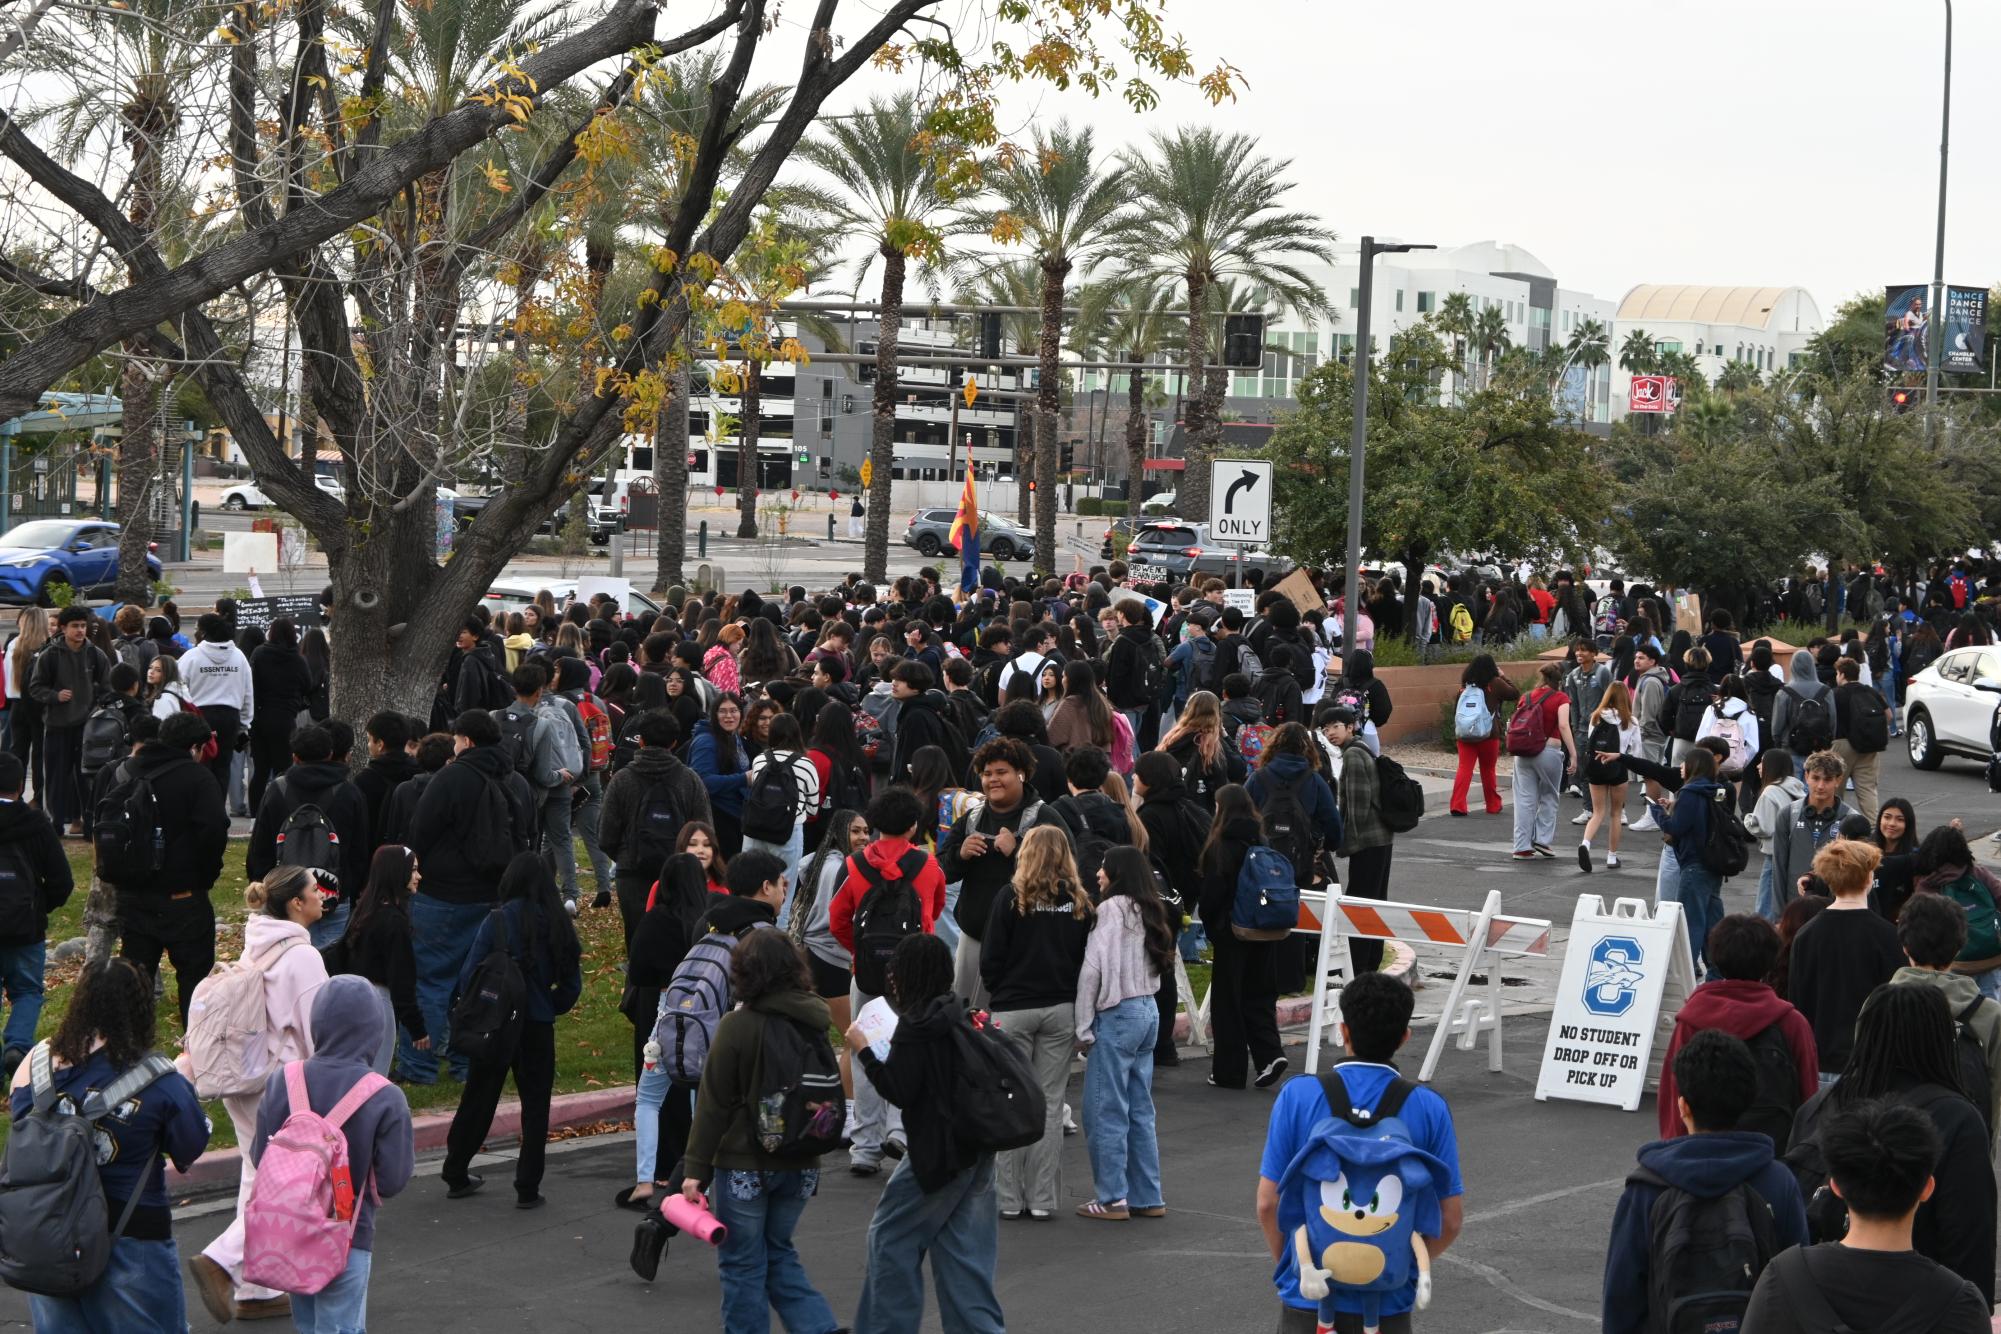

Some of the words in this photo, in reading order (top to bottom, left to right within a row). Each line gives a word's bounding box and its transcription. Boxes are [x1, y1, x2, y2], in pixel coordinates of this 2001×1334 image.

[1950, 291, 1984, 300] DANCE
[1950, 299, 1983, 309] DANCE
[1949, 307, 1982, 317] DANCE
[1633, 382, 1660, 400] Jack
[1219, 518, 1261, 535] ONLY
[1130, 563, 1140, 572] DID
[1142, 564, 1156, 573] WE
[1559, 1024, 1578, 1040] NO
[1580, 1027, 1641, 1047] STUDENT
[1553, 1047, 1590, 1064] DROP
[1593, 1051, 1619, 1067] OFF
[1620, 1054, 1638, 1070] OR
[1566, 1069, 1598, 1086] PICK
[1599, 1073, 1618, 1088] UP
